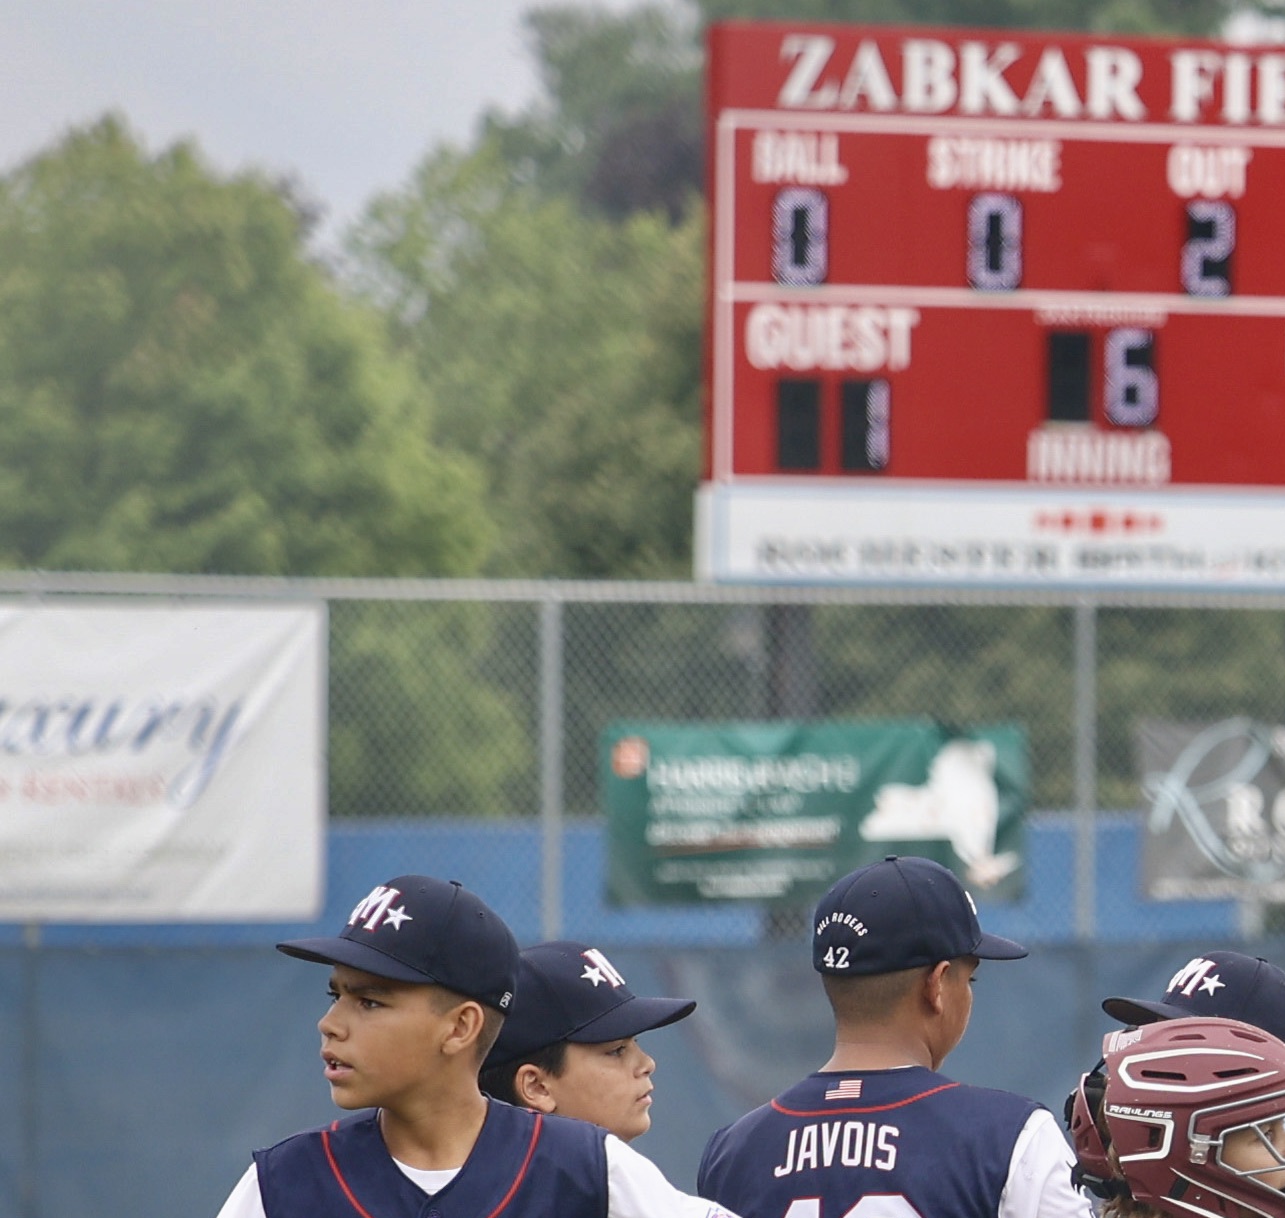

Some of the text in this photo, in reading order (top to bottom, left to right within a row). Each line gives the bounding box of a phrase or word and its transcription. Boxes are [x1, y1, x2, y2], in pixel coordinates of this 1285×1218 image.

[779, 33, 1146, 122] ZABKAR
[752, 131, 849, 186] BALL
[926, 136, 1063, 193] STRIKE
[1167, 144, 1251, 199] OUT
[772, 187, 829, 288] 0
[966, 192, 1023, 292] 0
[1181, 201, 1236, 298] 2
[745, 304, 921, 372] GUEST
[1103, 327, 1160, 427] 6
[866, 378, 891, 470] 1
[1026, 430, 1172, 484] INNING
[831, 912, 868, 937] ROGERS
[823, 946, 850, 969] 42
[1109, 1105, 1172, 1119] RAWLINGS
[774, 1121, 899, 1177] JAVOIS
